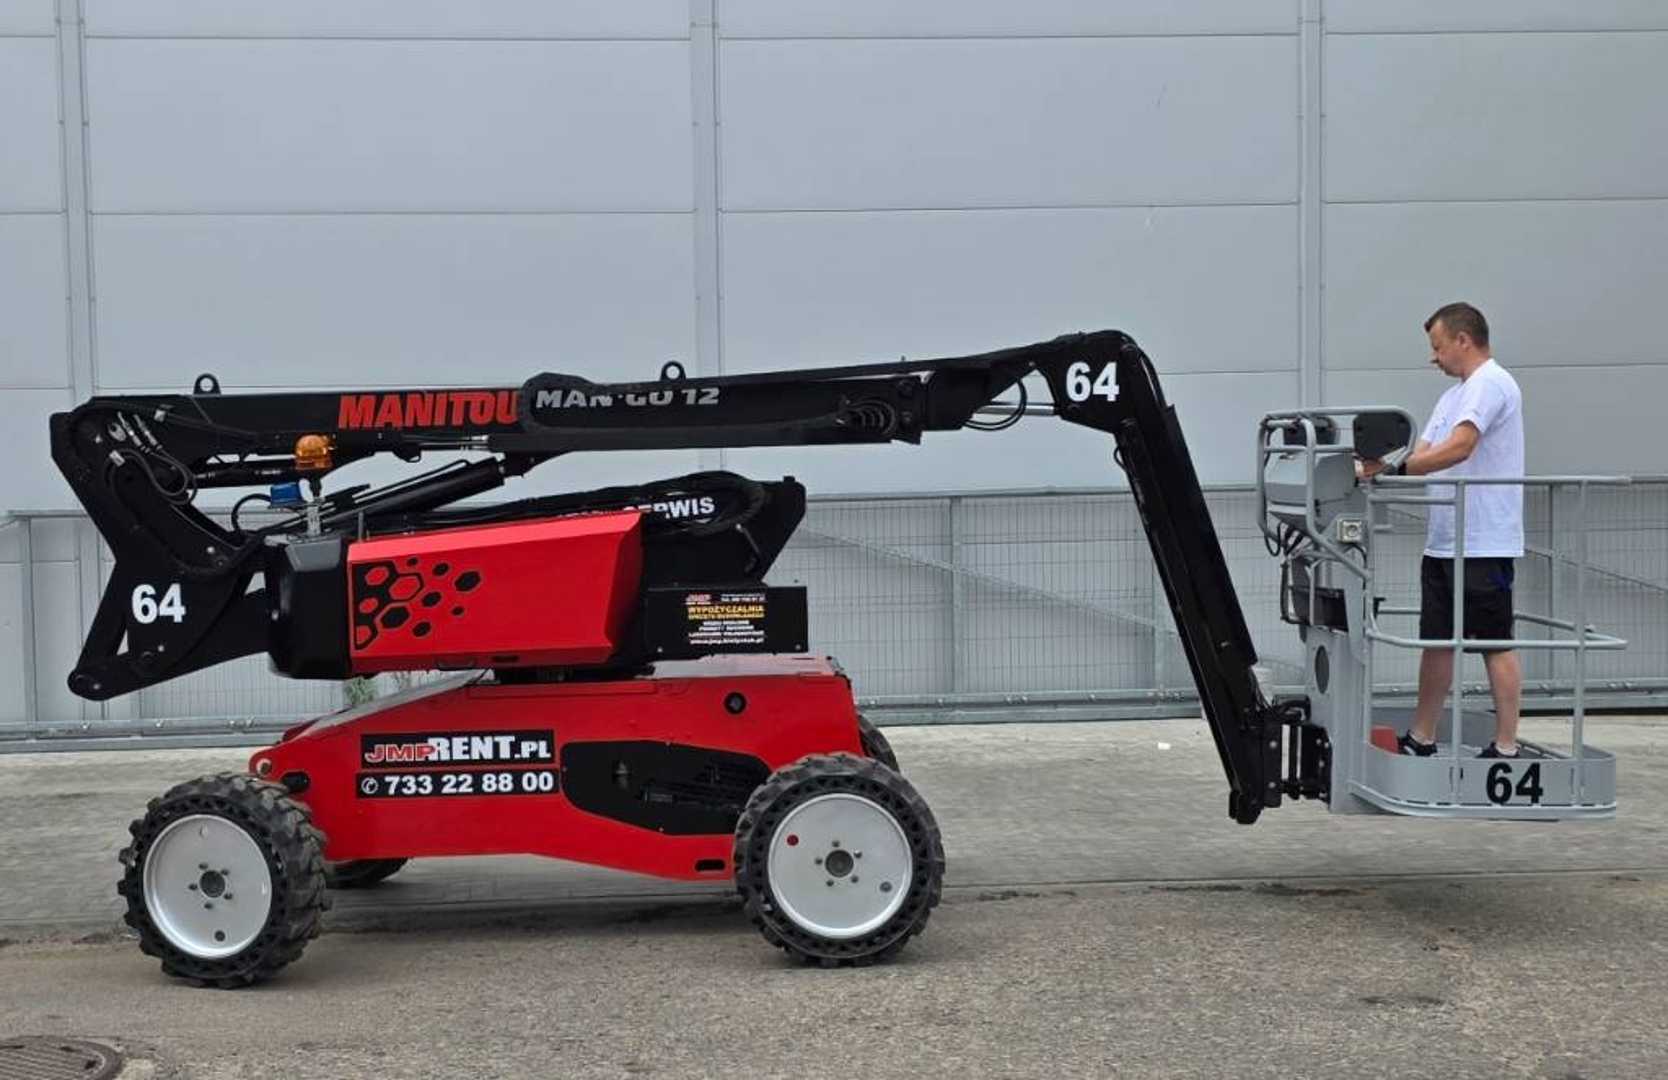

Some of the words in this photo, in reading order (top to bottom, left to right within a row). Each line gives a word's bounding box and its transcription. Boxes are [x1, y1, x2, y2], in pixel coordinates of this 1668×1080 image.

[681, 387, 720, 405] 12
[1065, 361, 1120, 402] 64
[338, 391, 519, 429] MANITOU
[131, 583, 186, 624] 64
[384, 773, 433, 795] 733
[441, 773, 474, 794] 22
[481, 772, 513, 793] 88
[522, 771, 554, 792] 00
[1486, 761, 1544, 805] 64
